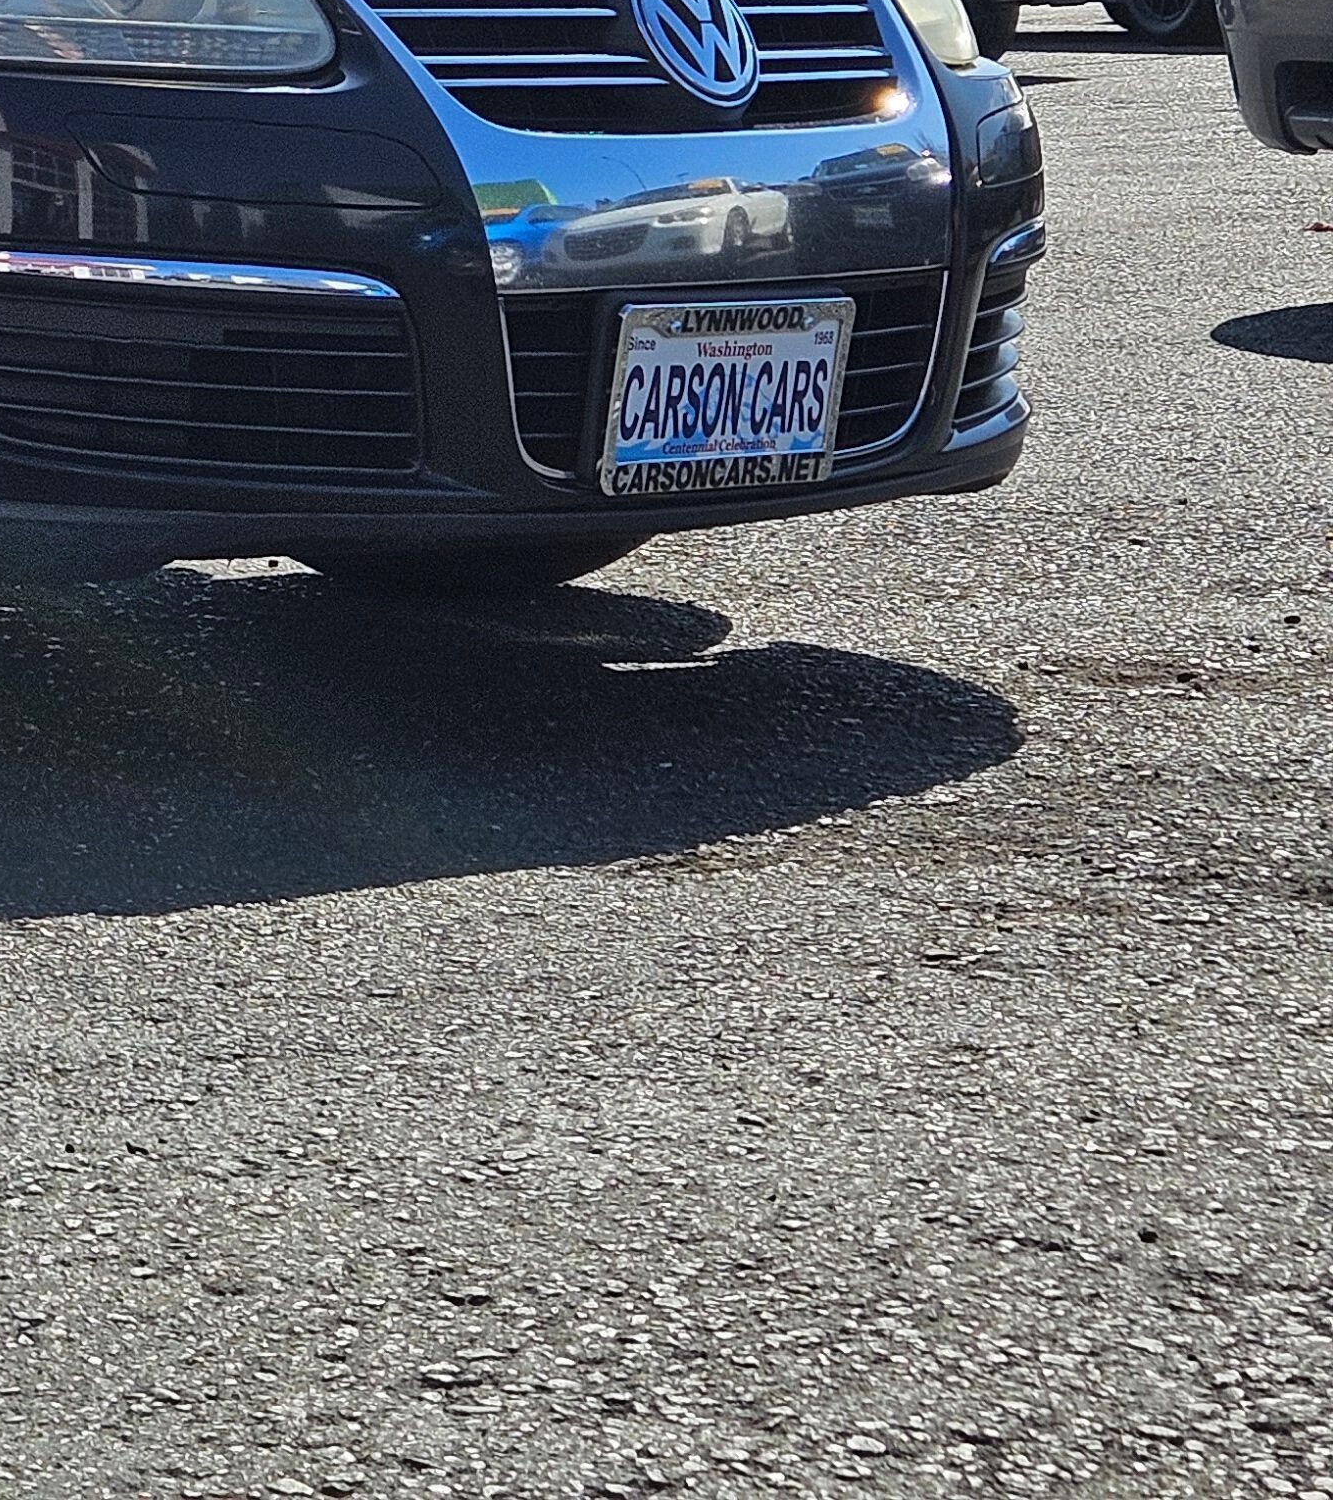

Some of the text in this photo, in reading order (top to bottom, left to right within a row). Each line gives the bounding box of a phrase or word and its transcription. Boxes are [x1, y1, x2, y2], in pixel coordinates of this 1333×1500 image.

[682, 306, 804, 333] LYNNWOOD
[627, 336, 657, 351] Since
[697, 341, 773, 360] Washington
[619, 358, 828, 441] CARSON CARS
[662, 437, 776, 455] Centennial Celebration
[611, 453, 825, 495] CARSONCARS.NET
